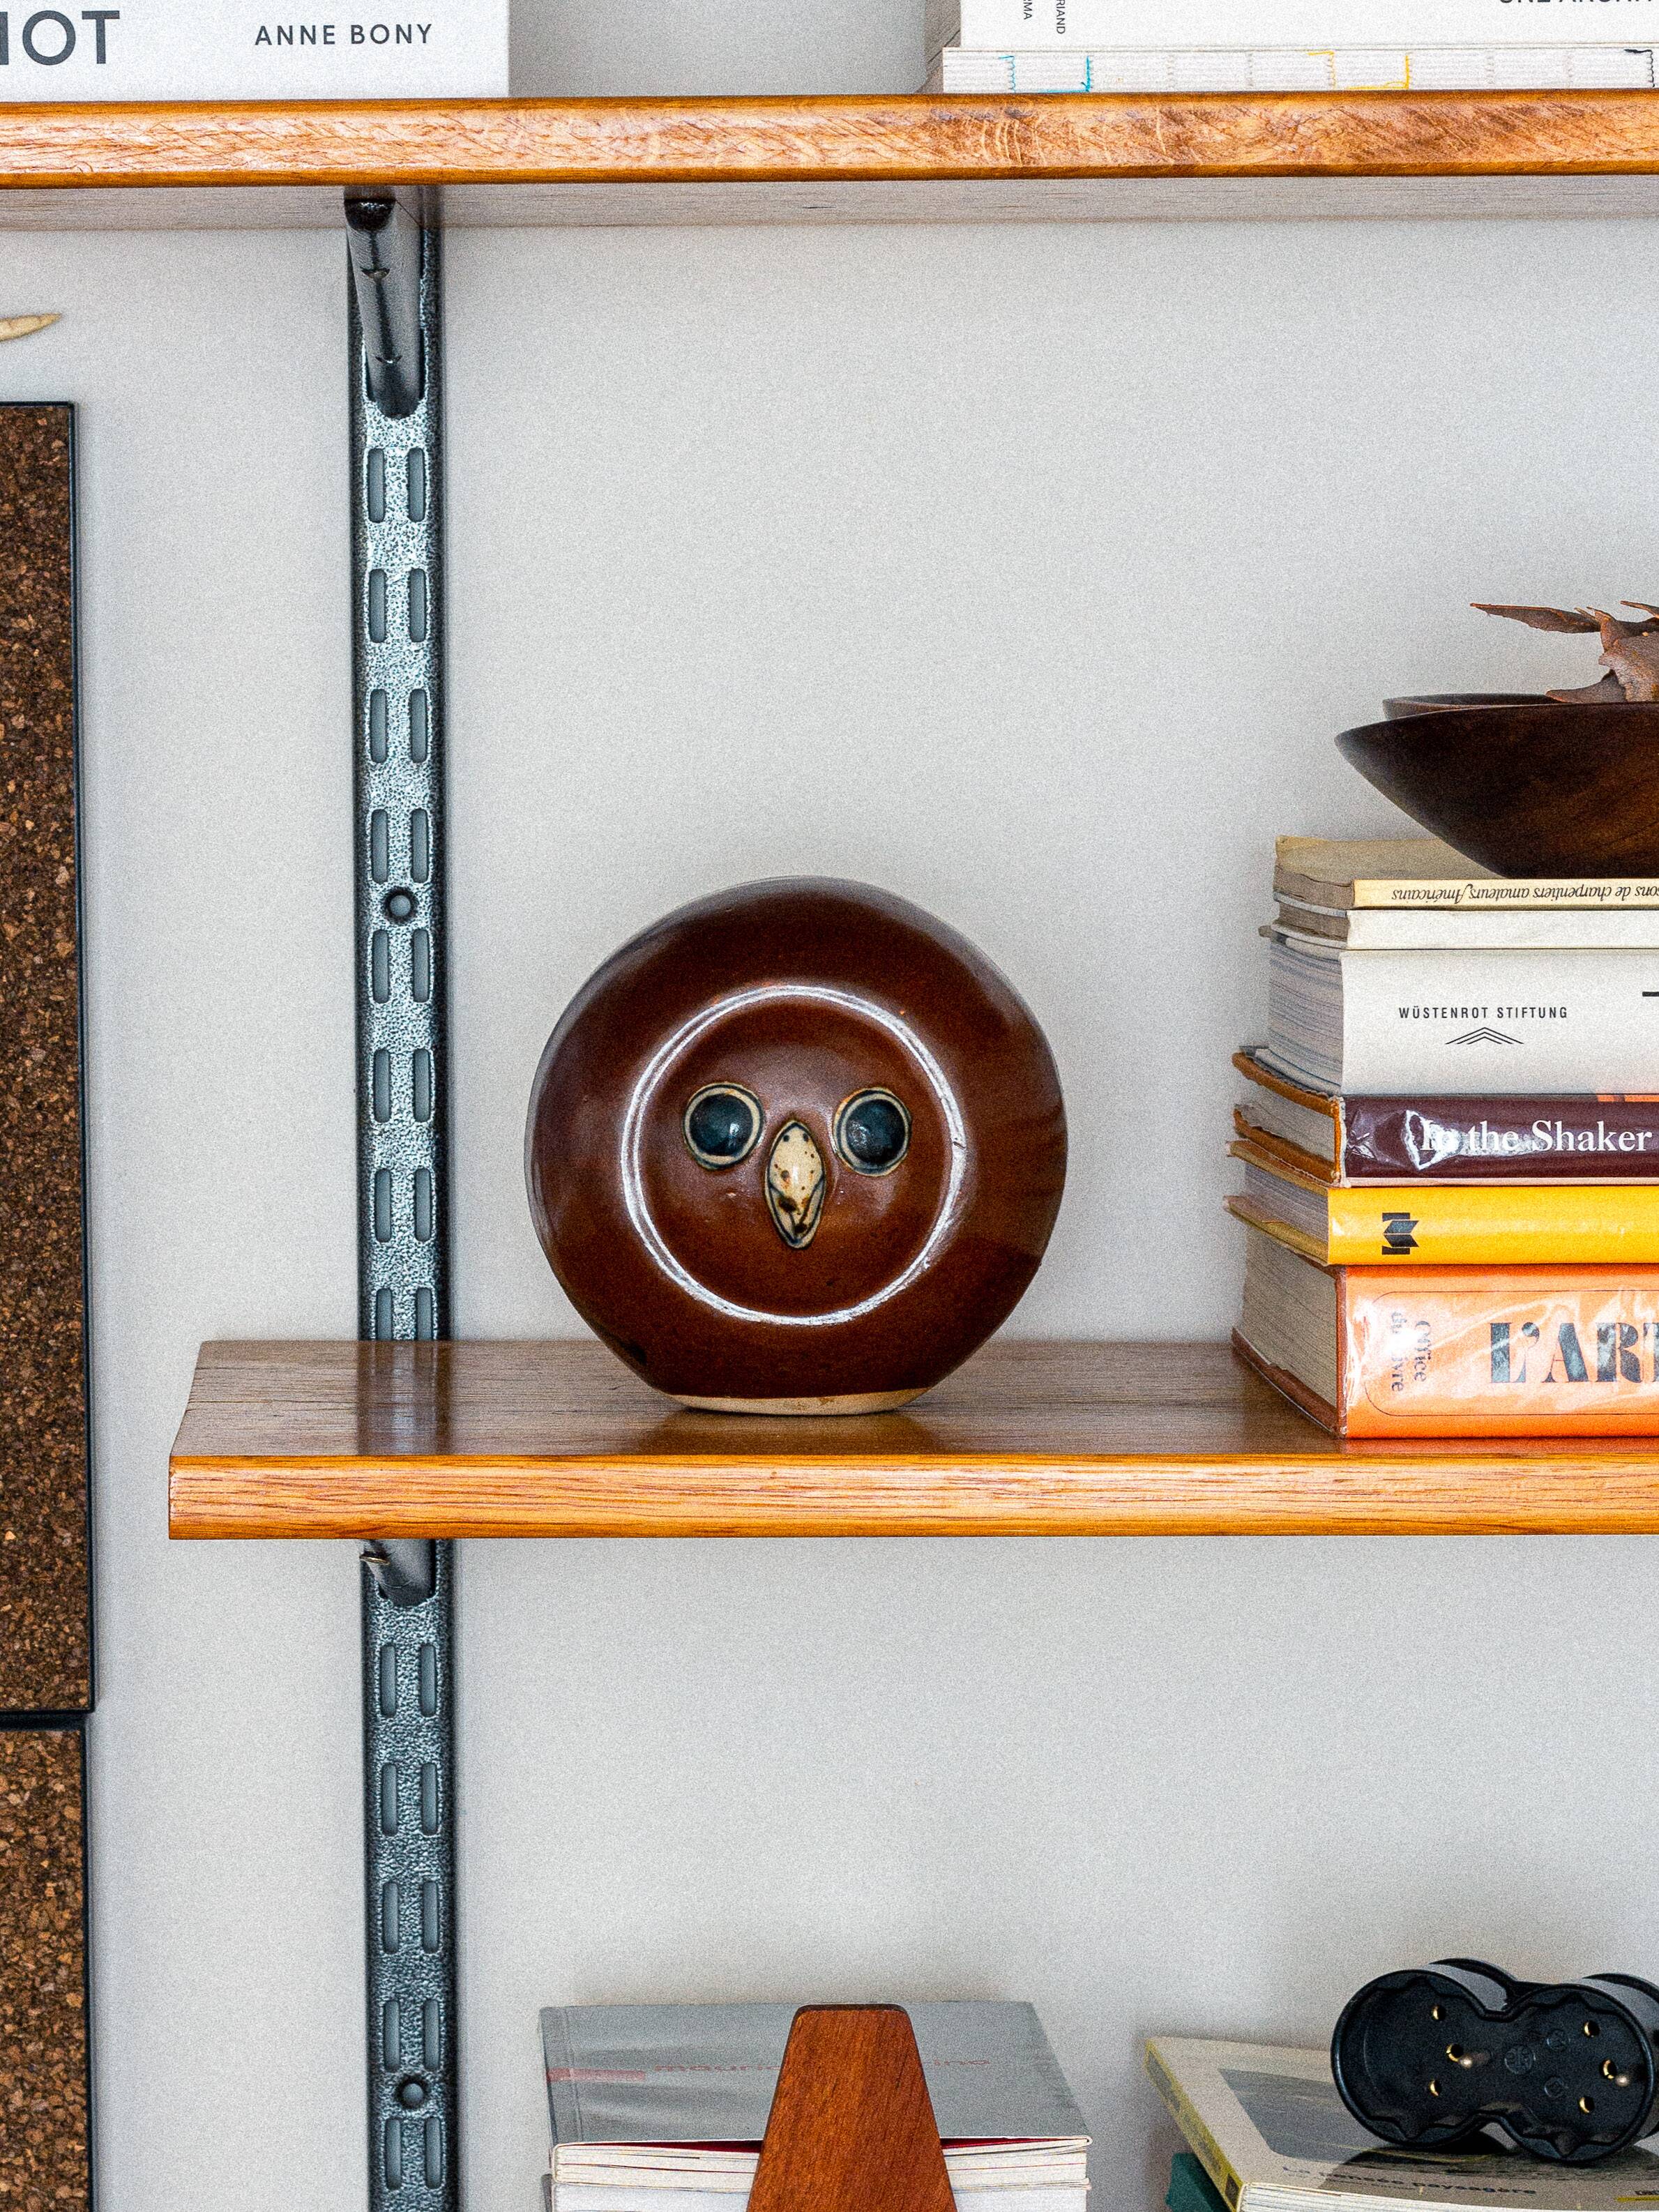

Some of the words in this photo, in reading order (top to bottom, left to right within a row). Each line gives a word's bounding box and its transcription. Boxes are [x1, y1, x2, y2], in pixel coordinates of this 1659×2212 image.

[255, 25, 335, 45] ANNE
[350, 24, 432, 44] BONY
[1391, 884, 1474, 904] Américains
[1470, 887, 1529, 900] amateurs
[1533, 884, 1612, 902] charpentiers
[1615, 886, 1630, 901] de
[1399, 1006, 1488, 1018] WÜSTENROT
[1497, 1006, 1568, 1018] STIFTUNG
[1469, 1121, 1519, 1151] the
[1532, 1119, 1653, 1151] Shaker
